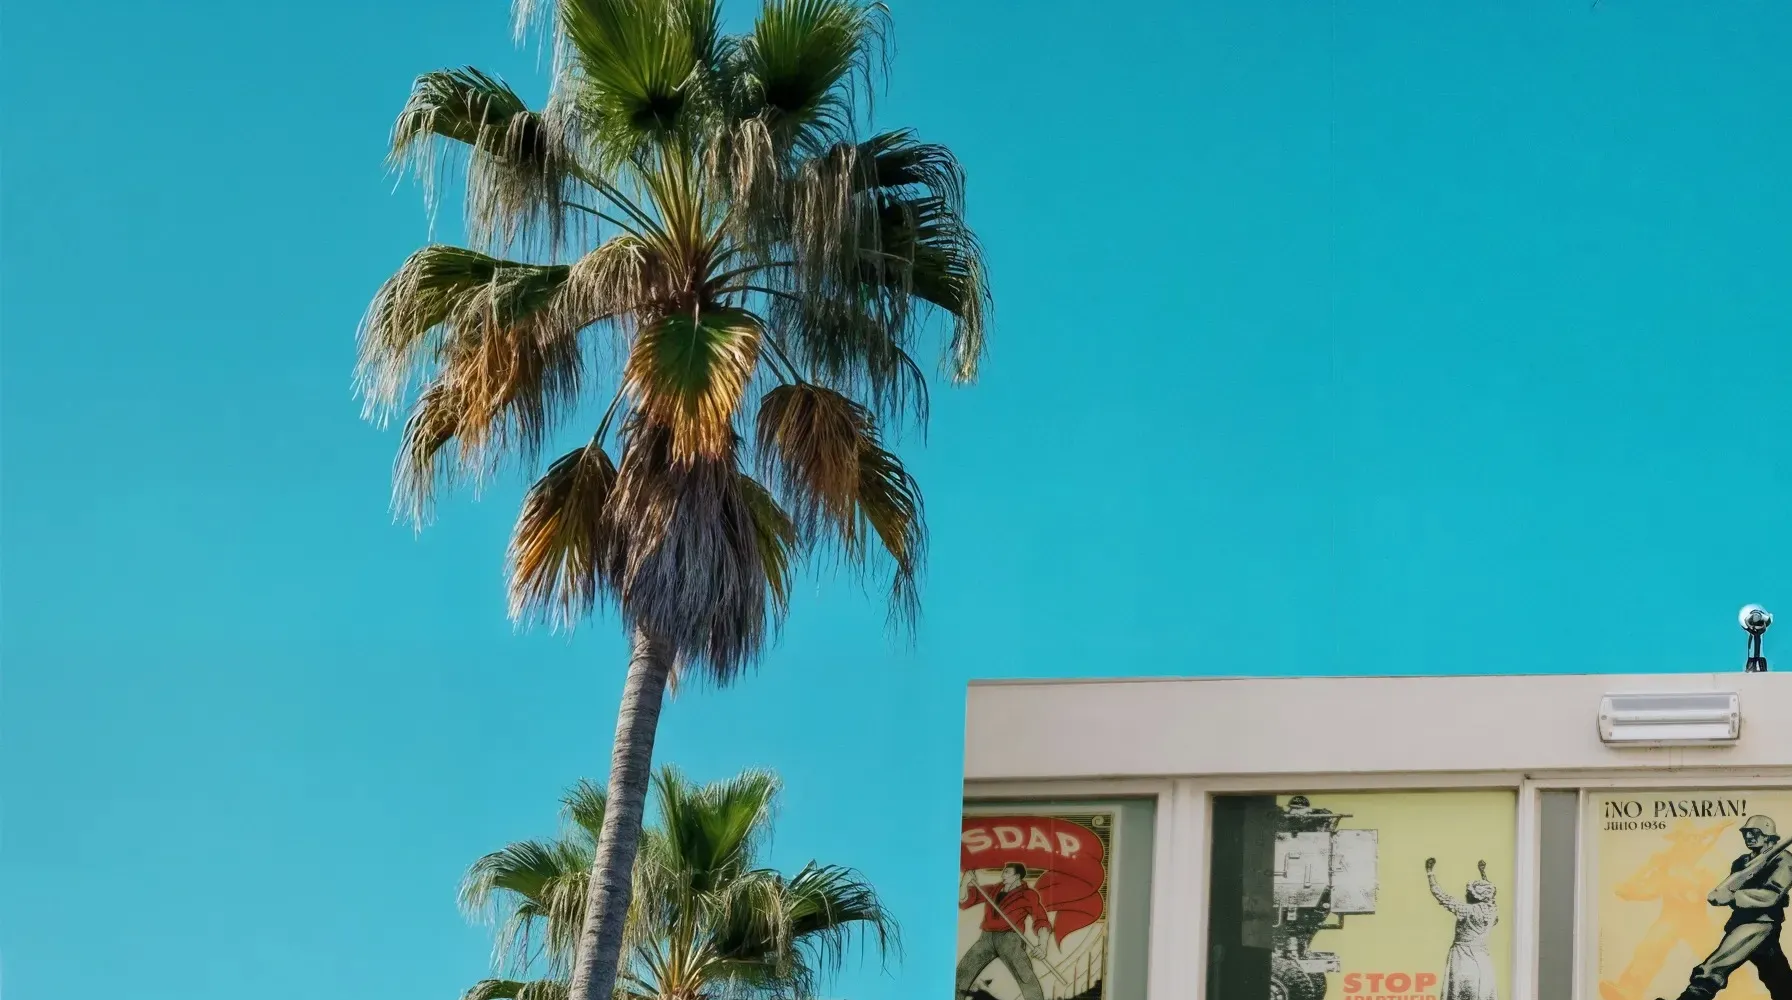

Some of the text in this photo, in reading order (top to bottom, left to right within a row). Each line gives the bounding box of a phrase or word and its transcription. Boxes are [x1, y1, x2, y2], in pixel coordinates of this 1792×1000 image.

[1604, 800, 1643, 819] ¡NO
[1604, 821, 1667, 831] JULIO 1936
[1342, 973, 1437, 993] STOP
